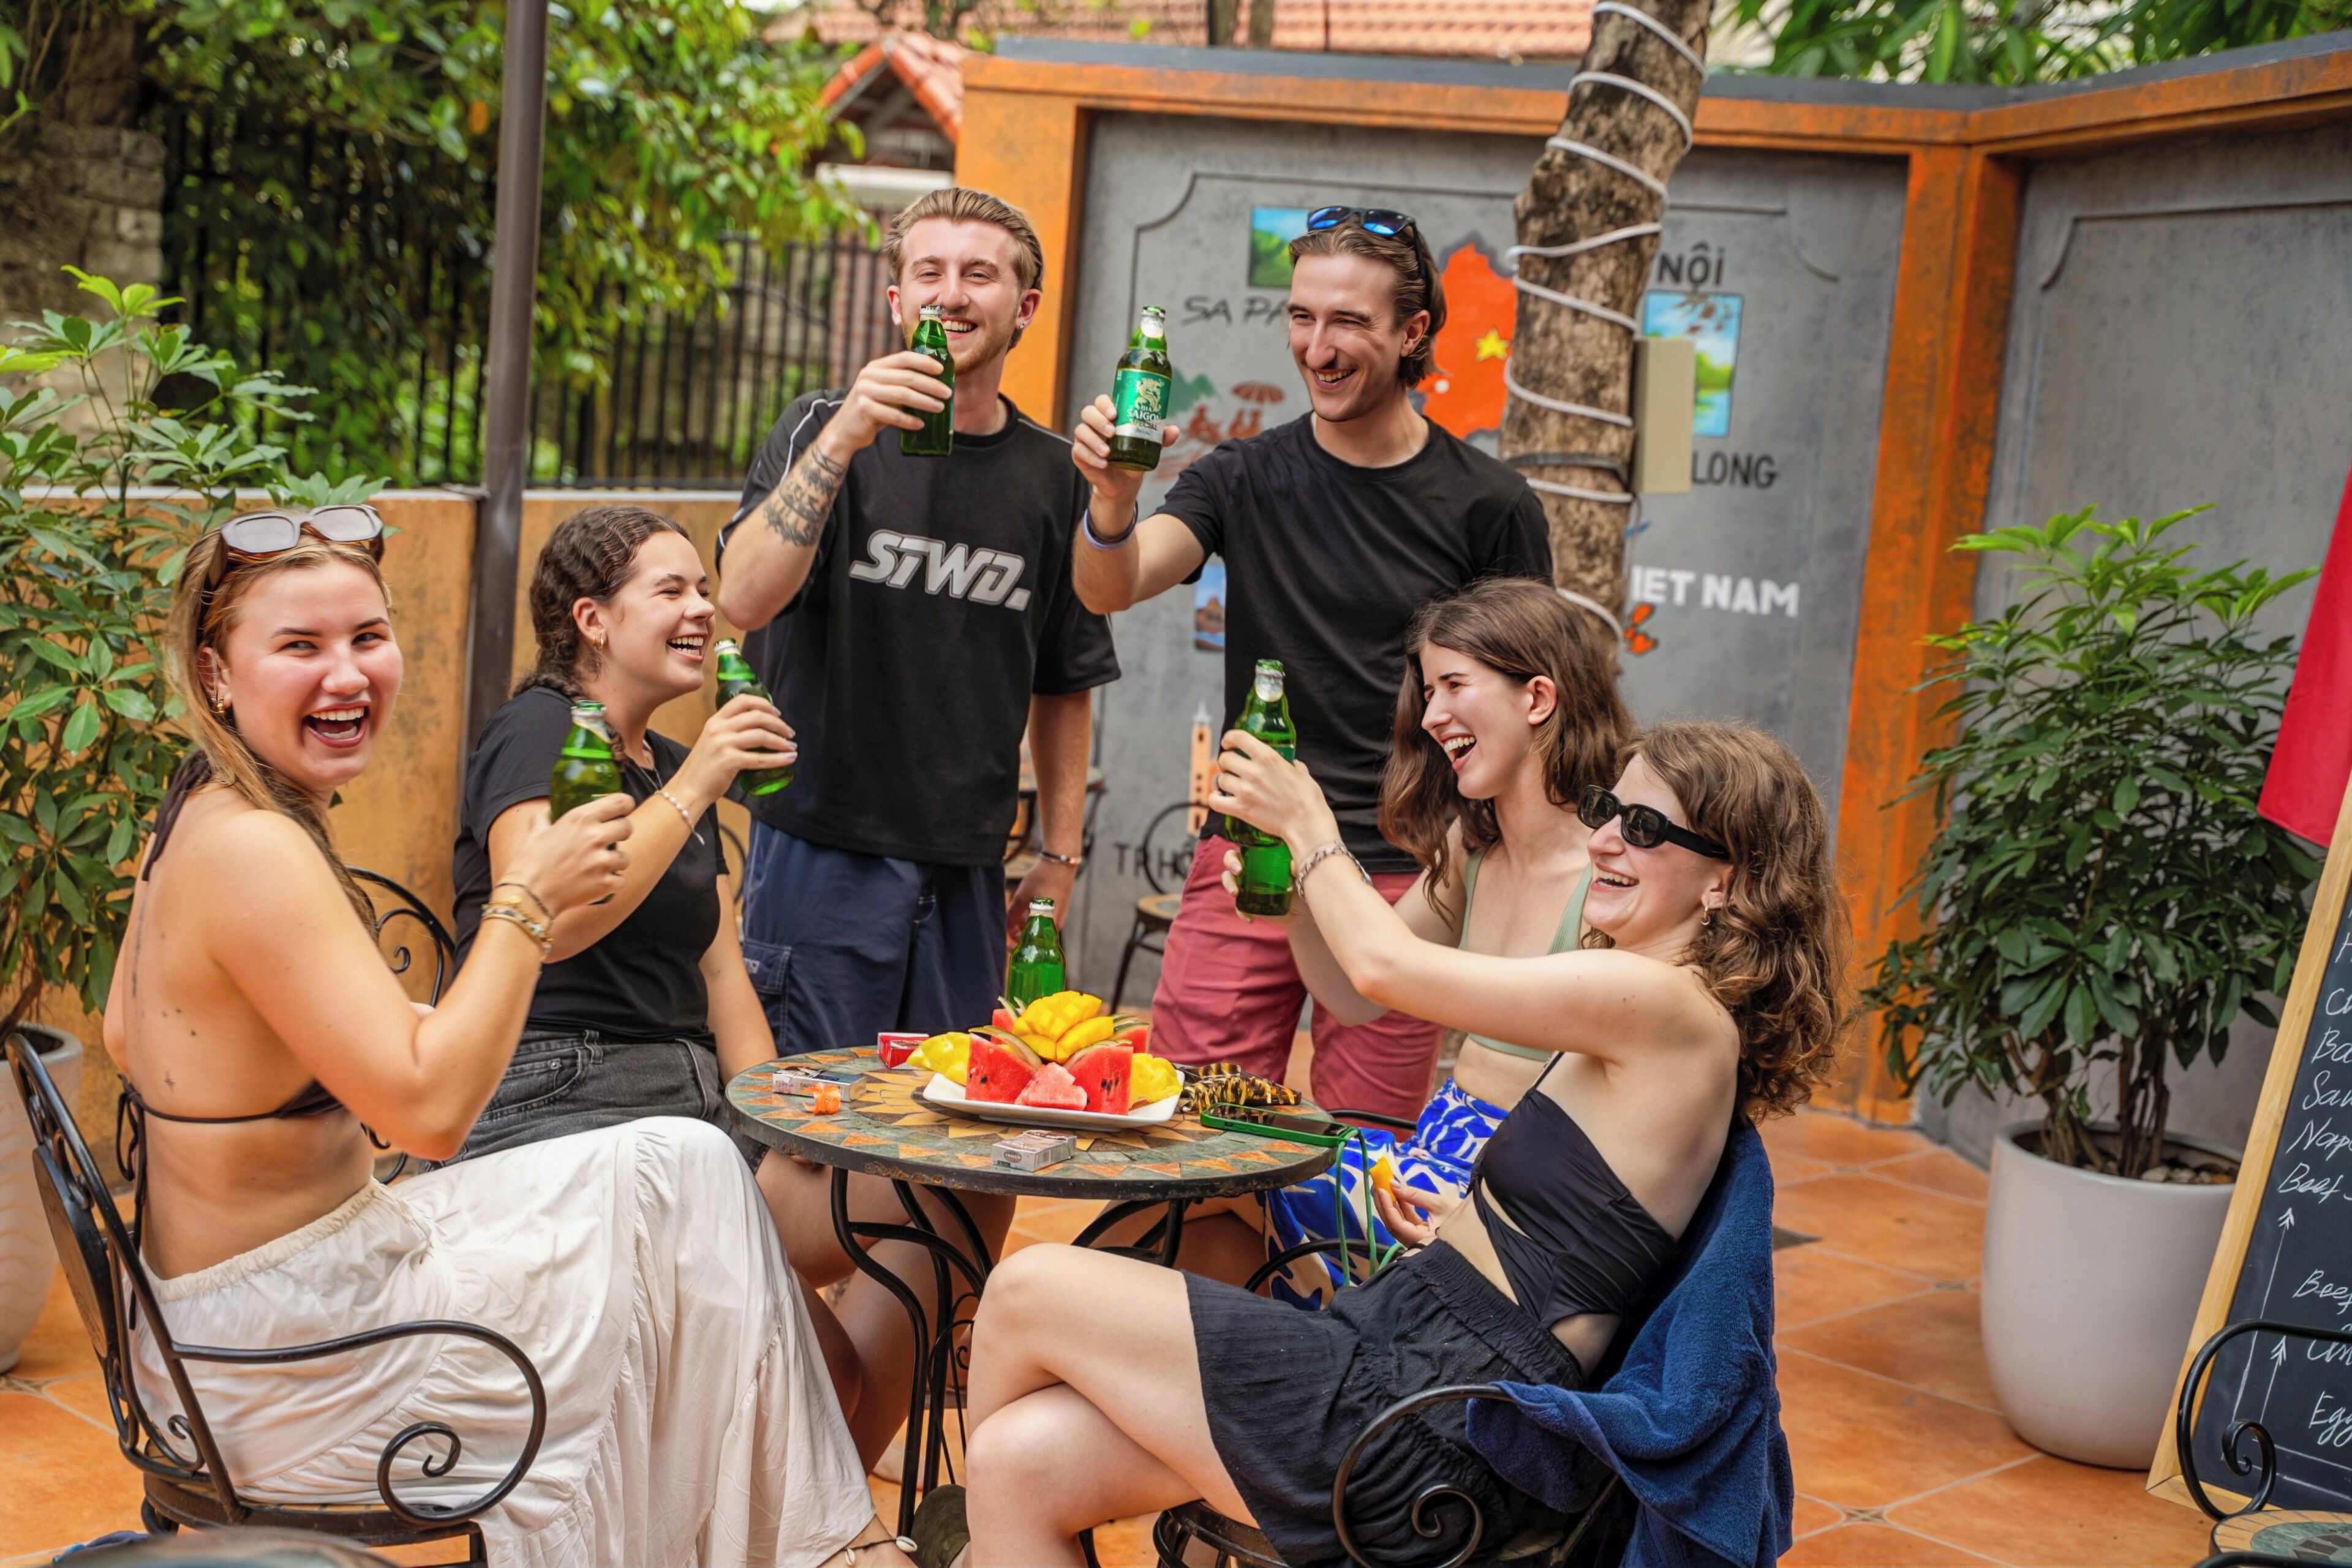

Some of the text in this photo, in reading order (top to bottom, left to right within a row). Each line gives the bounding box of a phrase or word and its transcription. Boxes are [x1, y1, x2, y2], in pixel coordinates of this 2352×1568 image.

[1181, 295, 1232, 326] SA
[1126, 407, 1161, 424] SAIGON
[1692, 450, 1779, 489] LONG
[1701, 573, 1800, 618] NAM
